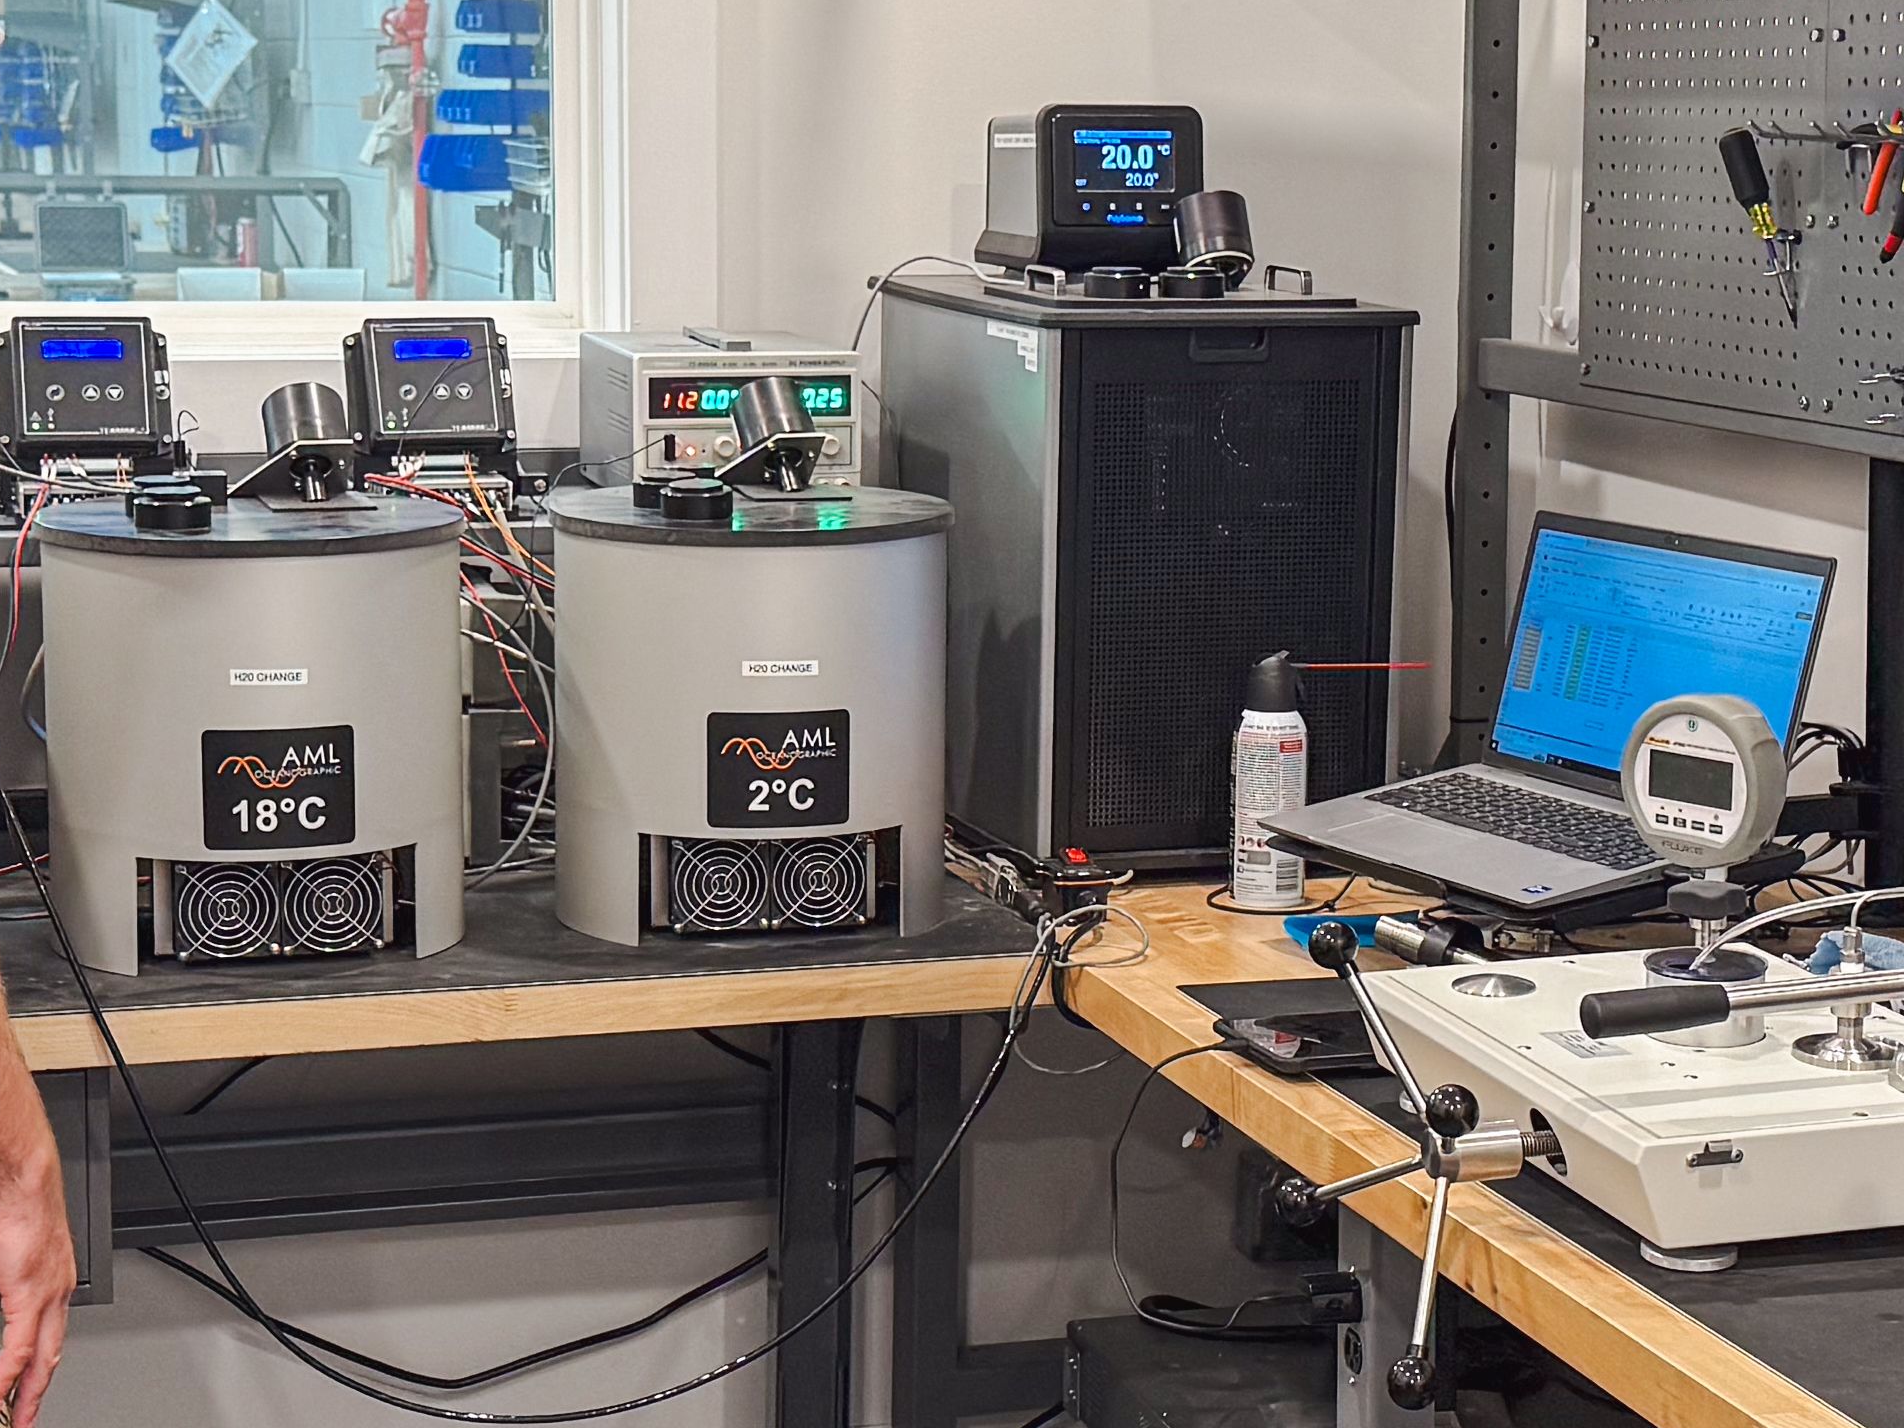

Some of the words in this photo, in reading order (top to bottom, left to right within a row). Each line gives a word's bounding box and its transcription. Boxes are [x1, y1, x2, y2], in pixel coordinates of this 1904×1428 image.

[1101, 144, 1154, 170] 20.0
[256, 672, 302, 682] CHANGE
[770, 663, 813, 673] CHANGE
[782, 727, 836, 749] AML
[282, 743, 340, 767] AML
[756, 749, 836, 760] OCEANOGRAPHIC
[255, 766, 341, 778] OCEANOGRAPHIC
[748, 778, 815, 811] 2°C
[232, 796, 326, 832] 18°C
